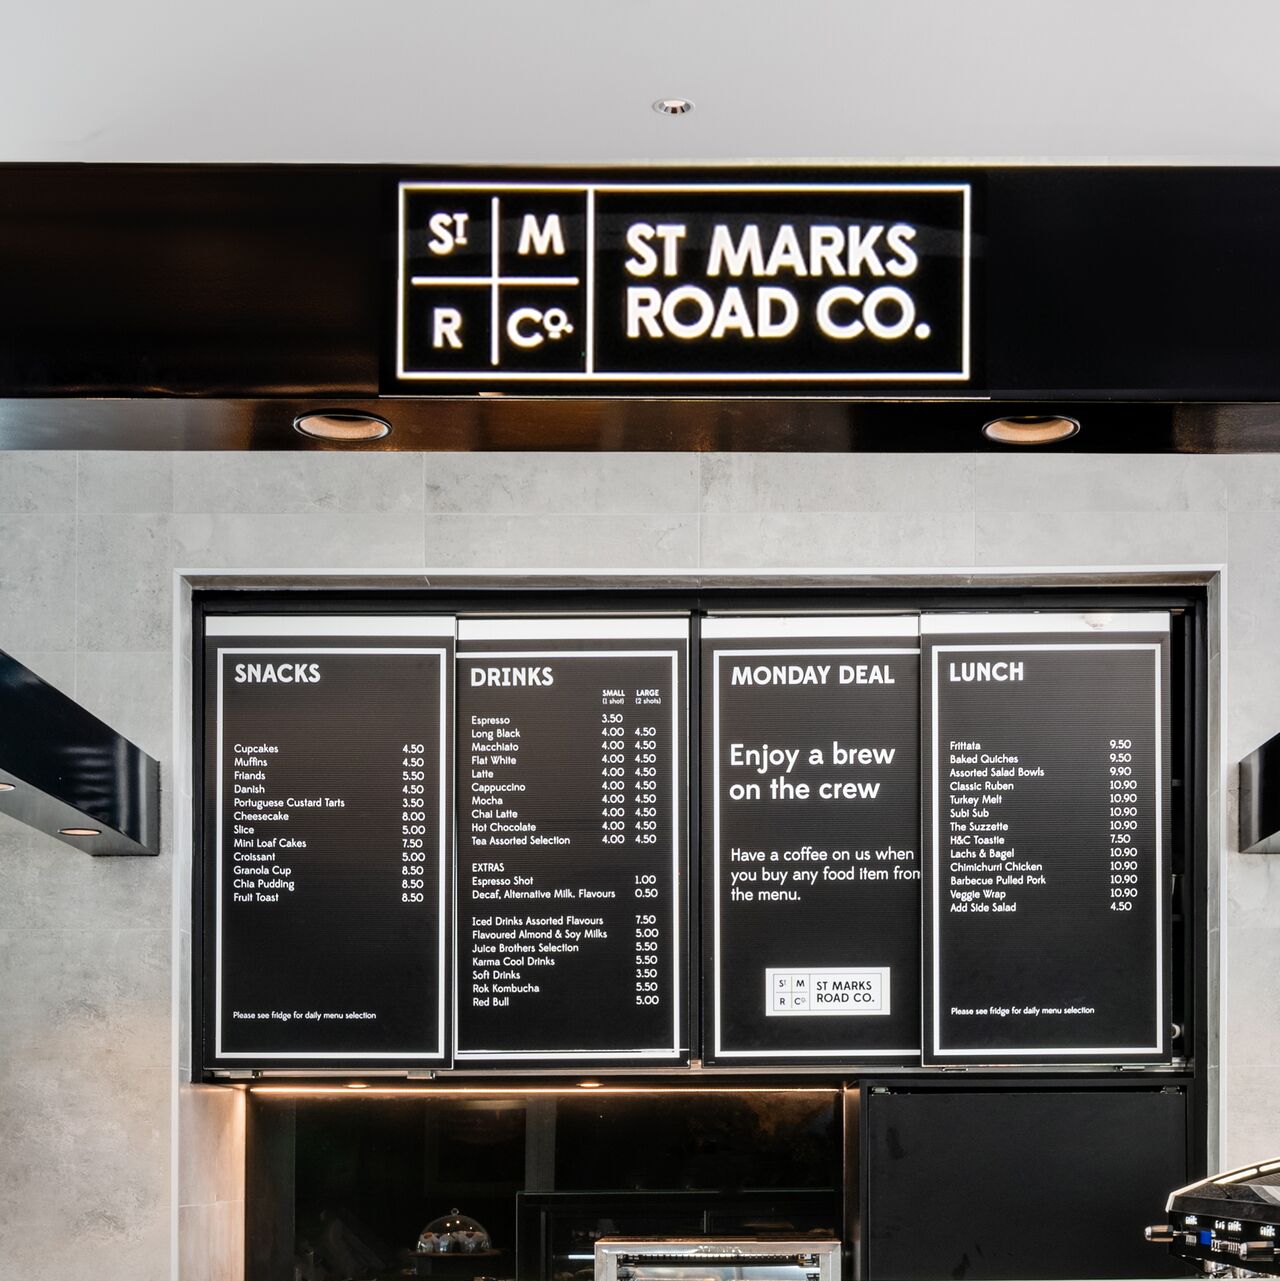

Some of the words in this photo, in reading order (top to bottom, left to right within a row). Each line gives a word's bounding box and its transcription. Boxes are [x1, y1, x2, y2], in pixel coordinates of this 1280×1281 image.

[518, 213, 565, 255] M
[625, 223, 686, 277] ST
[706, 223, 918, 277] MARKS
[627, 285, 799, 339] ROAD
[816, 286, 931, 339] CO.
[432, 308, 463, 349] R
[234, 663, 321, 683] SNACKS
[471, 667, 554, 686] DRINKS
[731, 665, 831, 685] MONDAY
[839, 665, 895, 684] DEAL
[950, 662, 1024, 682] LUNCH
[602, 689, 625, 697] SMALL
[636, 689, 659, 697] LARGE
[471, 715, 510, 727] Espresso
[602, 713, 623, 723] 3.50
[472, 729, 494, 741] Long
[496, 728, 521, 738] Black
[601, 727, 624, 737] 4.00
[635, 727, 656, 736] 4.50
[234, 743, 279, 755] Cupcakes
[402, 744, 424, 754] 4.50
[471, 742, 519, 751] Macchiato
[950, 741, 981, 750] Frittata
[234, 756, 268, 767] Muffins
[731, 743, 800, 774] Enjoy
[808, 749, 824, 765] a
[833, 741, 896, 765] brew
[950, 754, 978, 764] Baked
[980, 753, 1019, 764] Quiches
[1109, 766, 1132, 776] 9.90
[471, 782, 526, 794] Cappuccino
[729, 784, 760, 800] on
[770, 776, 810, 799] the
[819, 783, 880, 799] crew
[950, 781, 982, 791] Classic
[985, 781, 1014, 790] Ruben
[1110, 780, 1137, 790] 10.90
[234, 798, 284, 810] Portuguese
[286, 797, 322, 807] Custard
[324, 798, 345, 807] Tarts
[402, 798, 424, 808] 3.50
[233, 811, 289, 821] Cheesecake
[402, 811, 425, 821] 8.00
[472, 823, 487, 832] Hot
[490, 822, 536, 832] Chocolate
[950, 822, 967, 831] The
[969, 822, 1009, 831] Suzzette
[402, 839, 423, 848] 7.50
[1110, 834, 1131, 843] 7.50
[233, 852, 275, 861] Croissant
[731, 848, 766, 862] Have
[770, 851, 779, 861] a
[783, 846, 828, 861] coffee
[832, 851, 850, 861] on
[855, 850, 871, 860] us
[875, 846, 914, 860] when
[233, 865, 269, 875] Granola
[272, 865, 291, 877] Cup
[472, 862, 505, 872] EXTRAS
[950, 862, 1002, 872] Chimichurri
[1005, 861, 1042, 871] Chicken
[731, 871, 757, 886] you
[762, 867, 788, 885] buy
[792, 871, 818, 885] any
[823, 866, 855, 880] food
[859, 867, 888, 880] item
[951, 876, 993, 885] Barbecue
[996, 875, 1024, 885] Pulled
[1027, 875, 1046, 885] Pork
[472, 889, 501, 900] Decaf,
[504, 889, 551, 899] Alternative
[579, 889, 616, 898] Flavours
[731, 887, 753, 901] the
[758, 891, 801, 901] menu.
[635, 915, 656, 924] 7.50
[472, 944, 496, 953] Juice
[499, 943, 536, 953] Brothers
[538, 942, 579, 952] Selection
[636, 968, 657, 978] 3.50
[473, 983, 489, 993] Rok
[492, 983, 540, 993] Kombucha
[817, 981, 828, 991] ST
[832, 981, 872, 990] MARKS
[473, 997, 490, 1006] Red
[493, 997, 509, 1006] Bull
[817, 993, 849, 1003] ROAD
[853, 993, 874, 1002] CO.
[233, 1011, 256, 1019] Please
[271, 1011, 292, 1021] fridge
[293, 1011, 303, 1019] for
[305, 1011, 322, 1021] daily
[345, 1011, 376, 1019] selection
